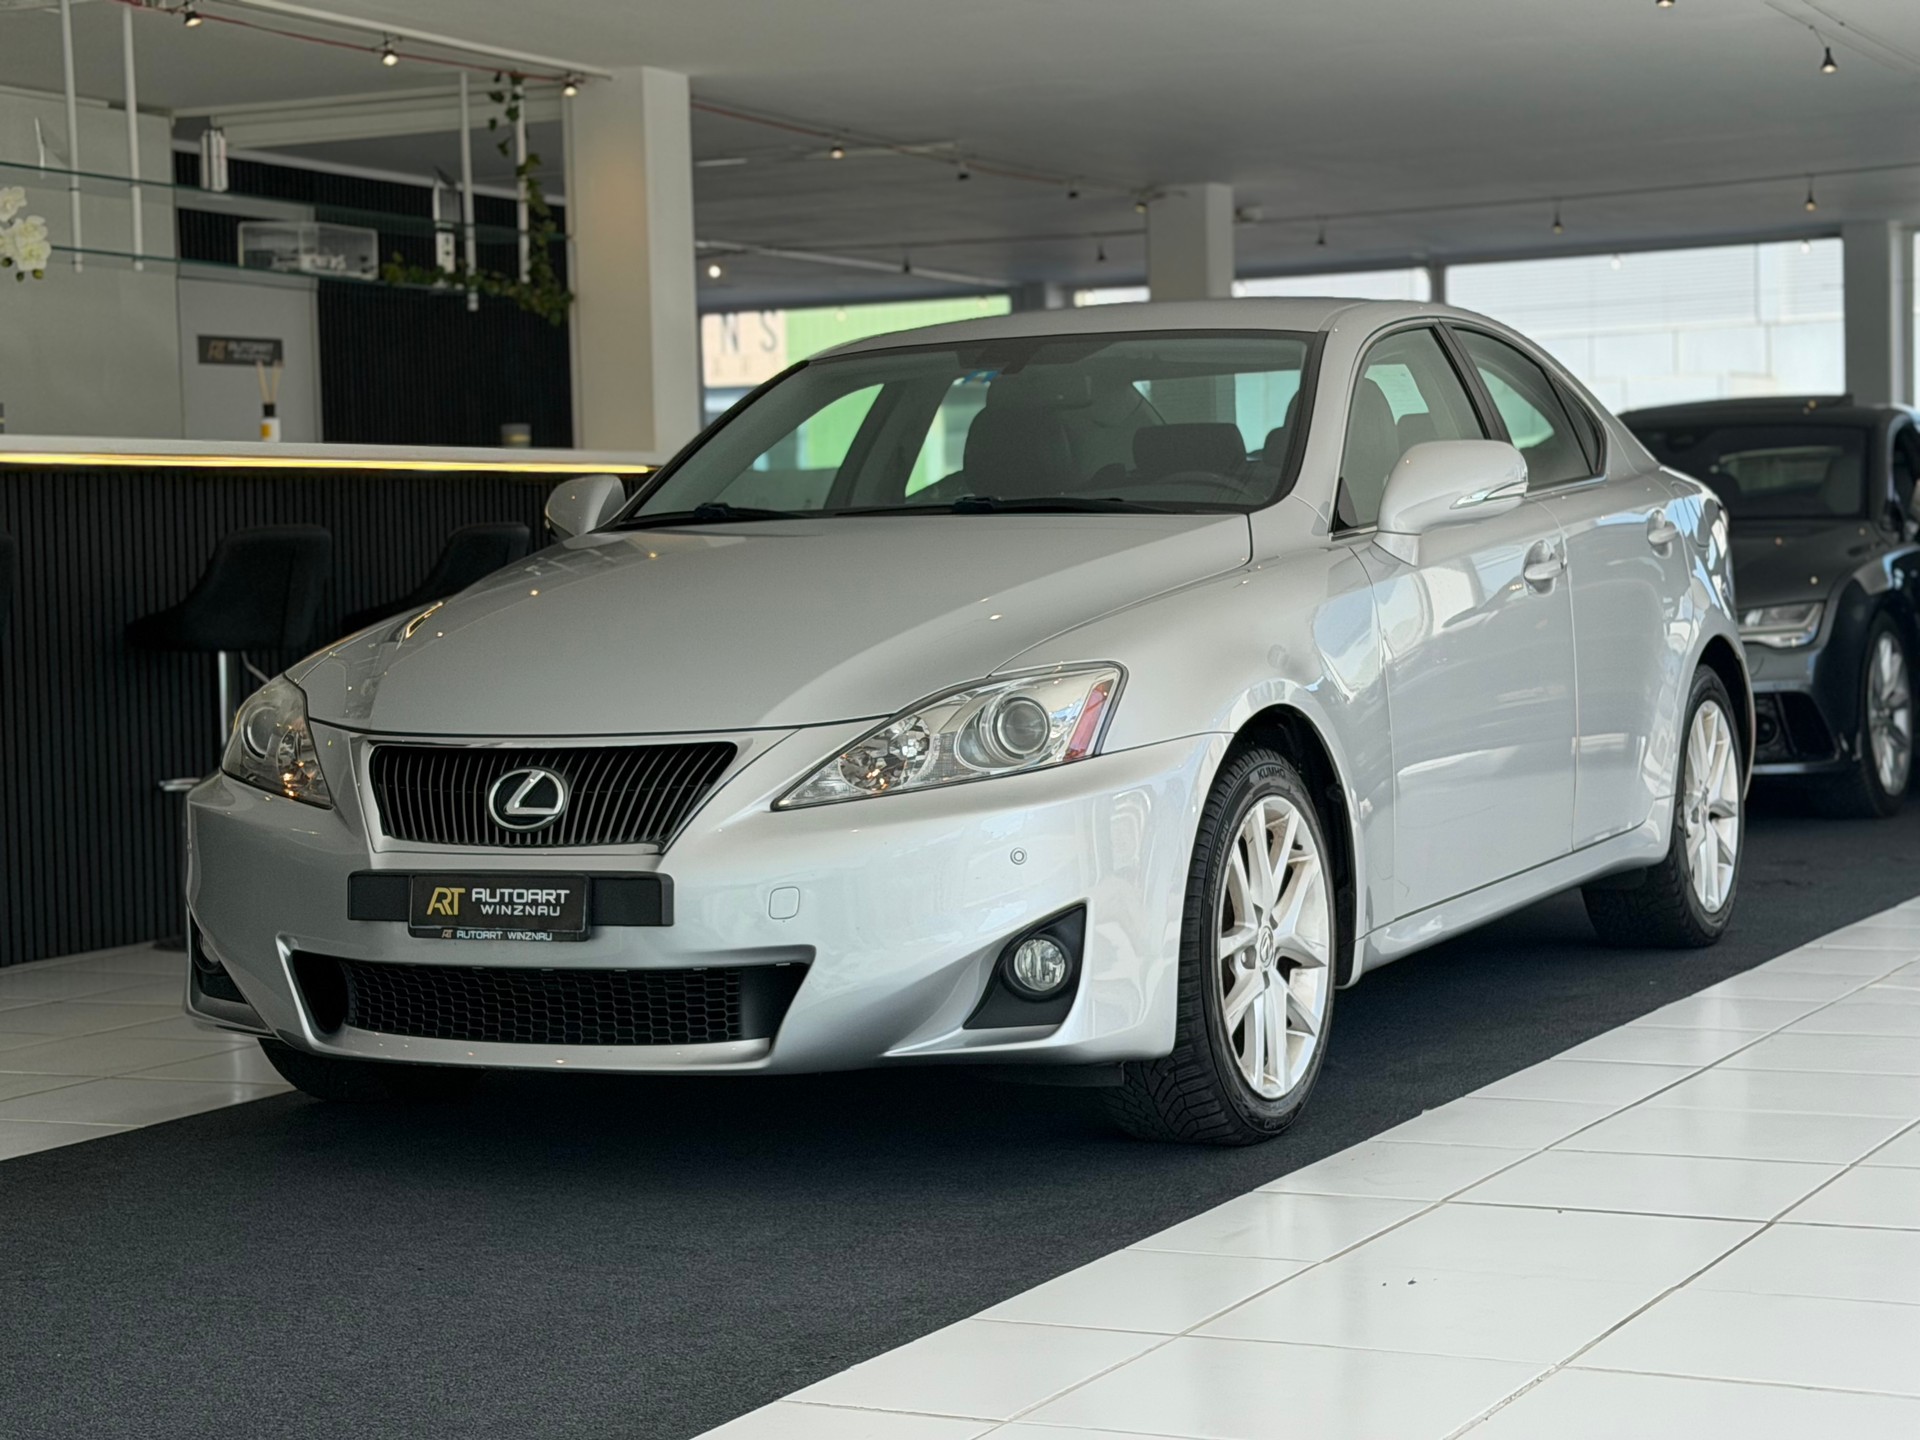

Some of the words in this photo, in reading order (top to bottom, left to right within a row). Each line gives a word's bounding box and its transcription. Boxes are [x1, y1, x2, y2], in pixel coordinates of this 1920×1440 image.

[1257, 766, 1286, 780] KUMHO
[471, 888, 570, 904] AUTOART
[480, 904, 561, 917] WINZNAU
[456, 930, 503, 940] AUTOART
[507, 931, 553, 941] WINZNAU
